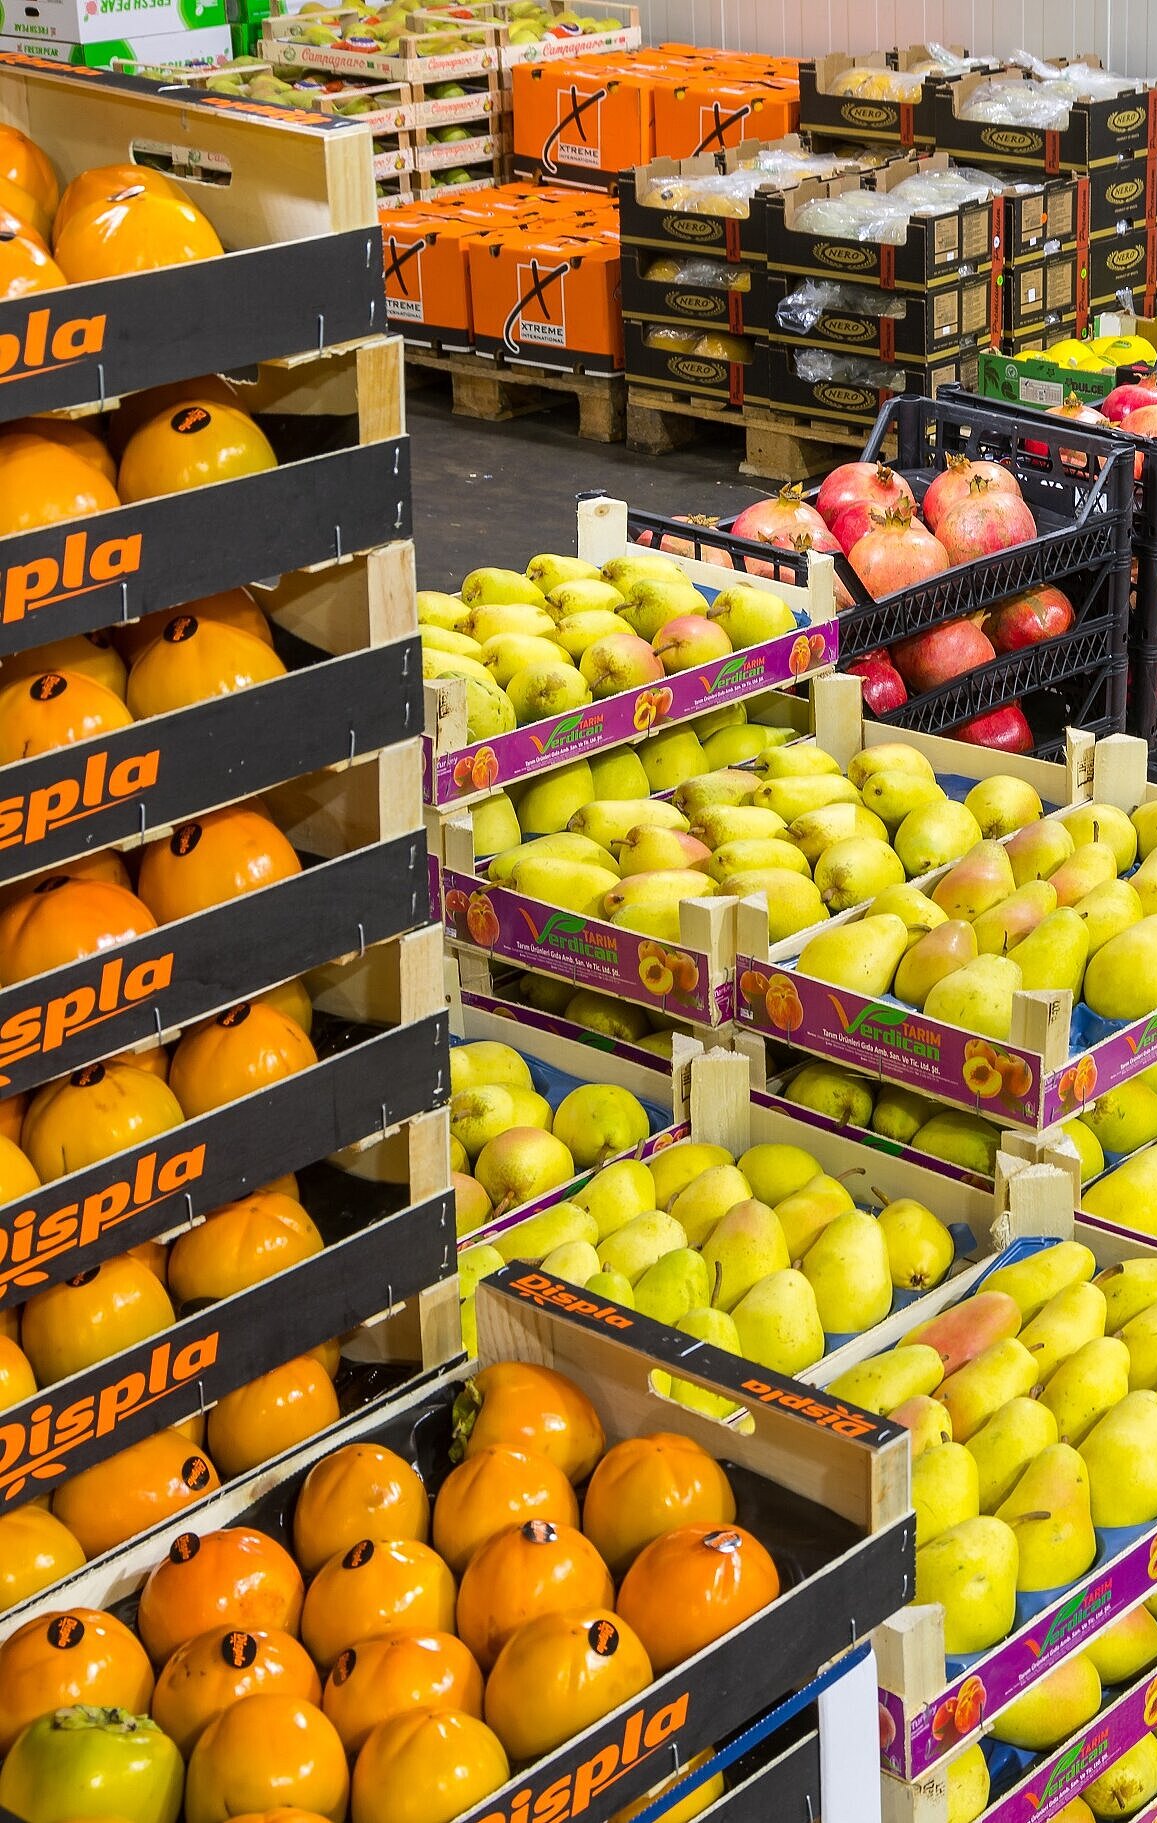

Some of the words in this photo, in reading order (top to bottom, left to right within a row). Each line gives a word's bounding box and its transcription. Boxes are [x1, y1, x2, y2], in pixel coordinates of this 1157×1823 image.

[854, 105, 884, 119] NERO
[1116, 112, 1136, 124] NERO
[996, 129, 1026, 145] NERO
[560, 143, 599, 158] XTREME
[1115, 184, 1134, 196] NERO
[677, 219, 707, 233] NERO
[828, 246, 862, 262] NERO
[1116, 249, 1135, 261] NERO
[386, 299, 421, 312] TREME
[679, 295, 710, 309] NERO
[521, 321, 564, 337] XTREME
[828, 319, 860, 333] NERO
[682, 361, 710, 375] NERO
[828, 387, 859, 402] NERO
[2, 533, 143, 624] pla
[743, 656, 765, 671] TARIM
[580, 714, 605, 731] TARIM
[518, 911, 619, 964] Verdican
[583, 930, 618, 951] TARIM
[1, 952, 175, 1053] spla
[828, 994, 940, 1061] Verdican
[903, 1022, 941, 1047] TARIM
[514, 1273, 634, 1329] Displa
[741, 1379, 874, 1437] Displa
[1083, 1577, 1113, 1607] TARIM
